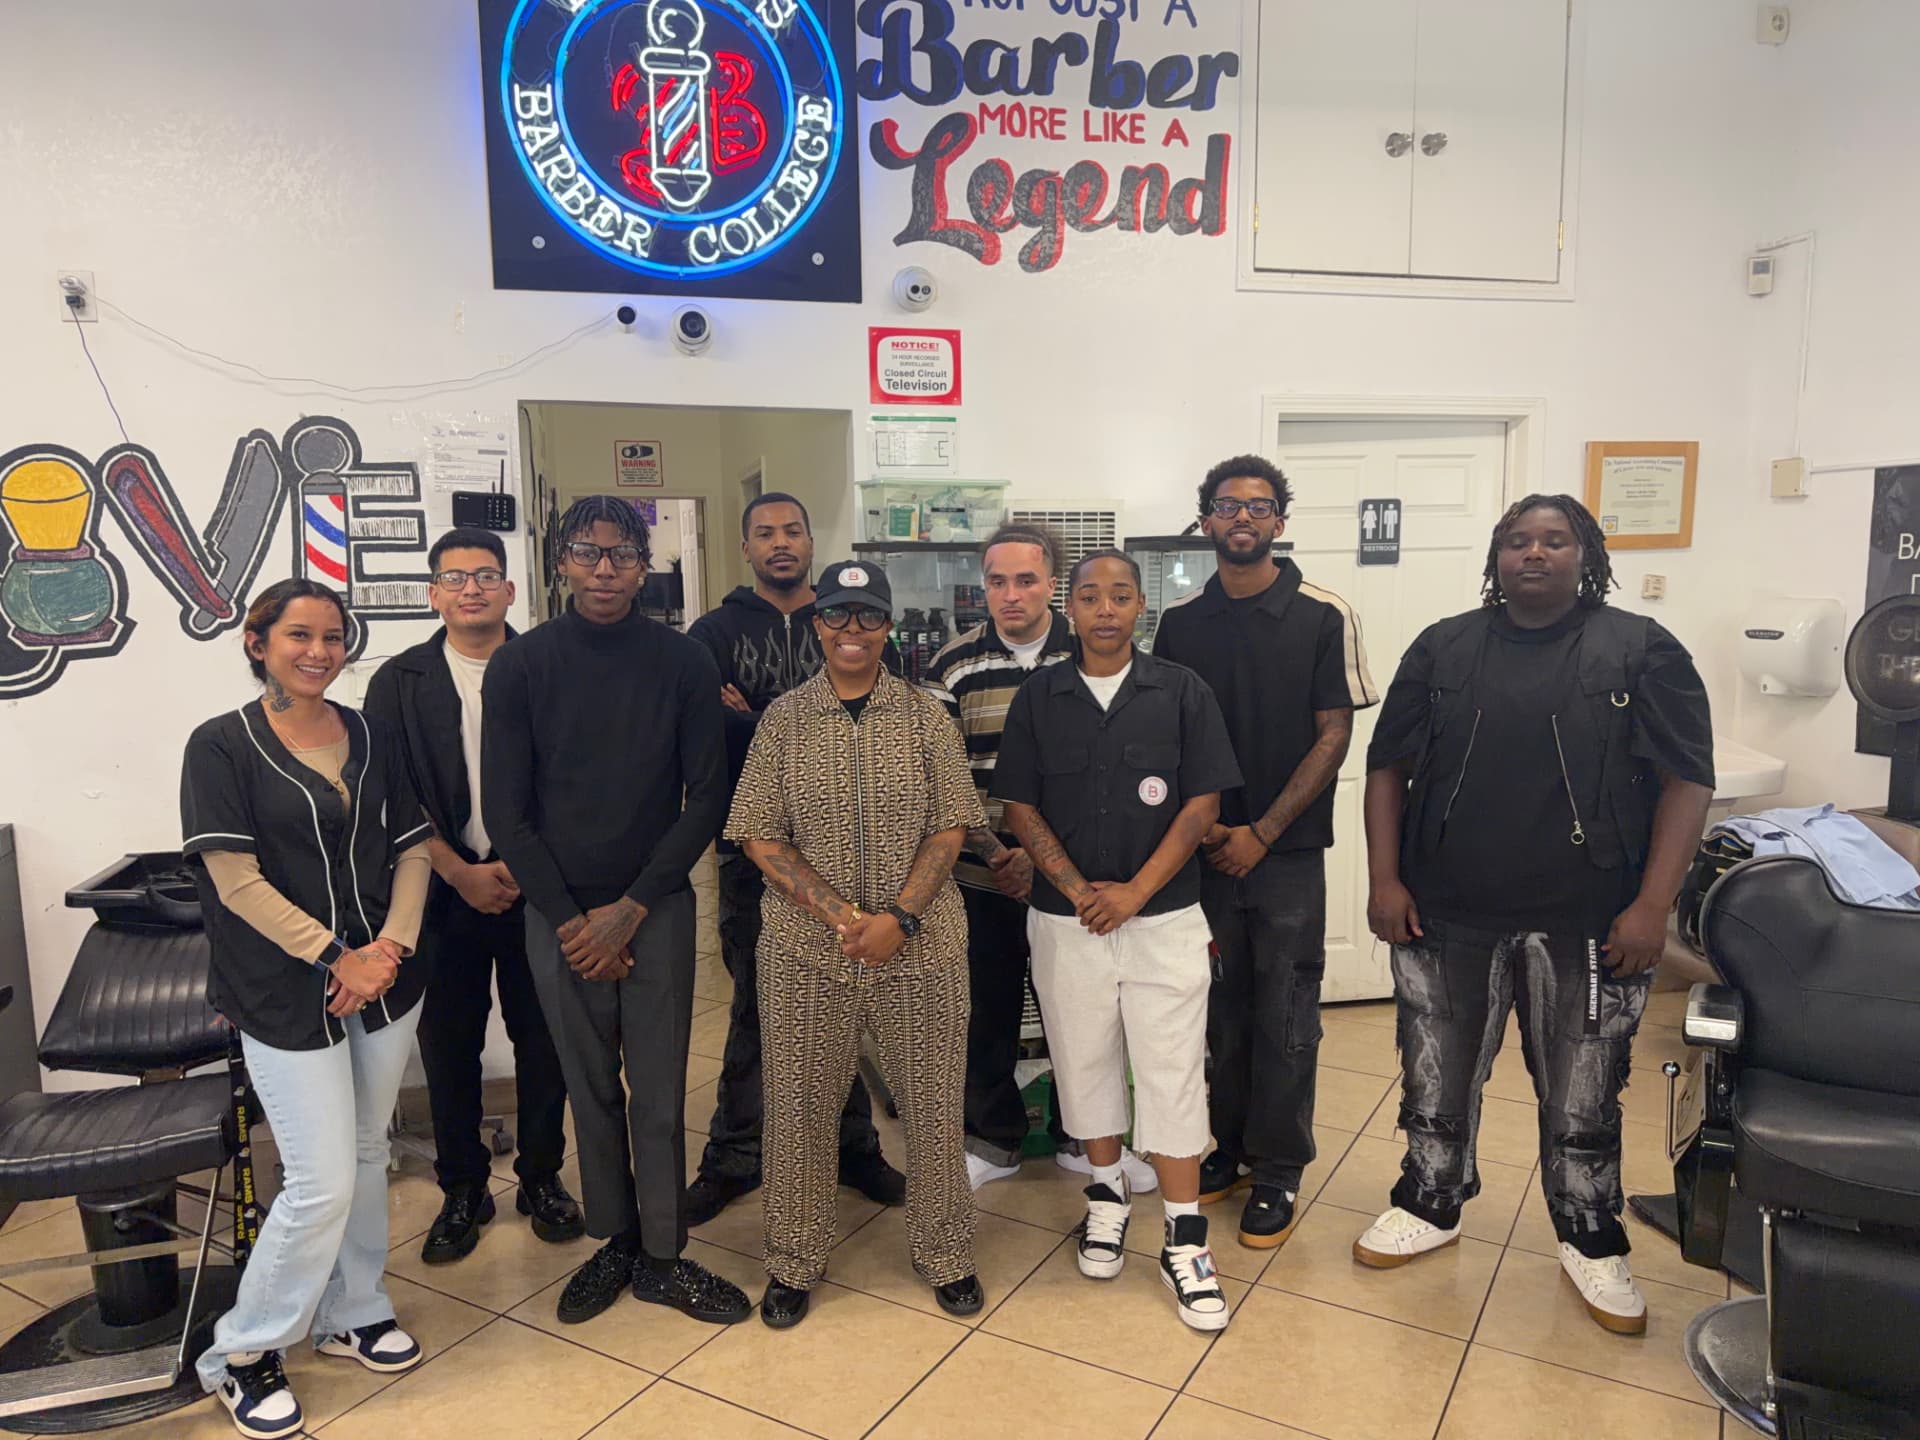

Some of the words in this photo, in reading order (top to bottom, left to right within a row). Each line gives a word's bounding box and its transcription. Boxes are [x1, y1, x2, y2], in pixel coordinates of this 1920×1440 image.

[857, 0, 1239, 110] Barber
[979, 102, 1067, 140] MORE
[1083, 110, 1146, 144] LIKE
[1161, 118, 1189, 148] A
[514, 83, 653, 258] BARBER
[689, 95, 833, 265] COLLEGE
[869, 112, 1231, 273] Legend
[891, 341, 940, 349] NOTICE!
[884, 368, 915, 377] Closed
[918, 369, 948, 378] Circuit
[885, 378, 947, 391] Television
[622, 459, 657, 468] WARNING
[238, 1106, 247, 1142] RAMS
[243, 1168, 253, 1203] RAMS
